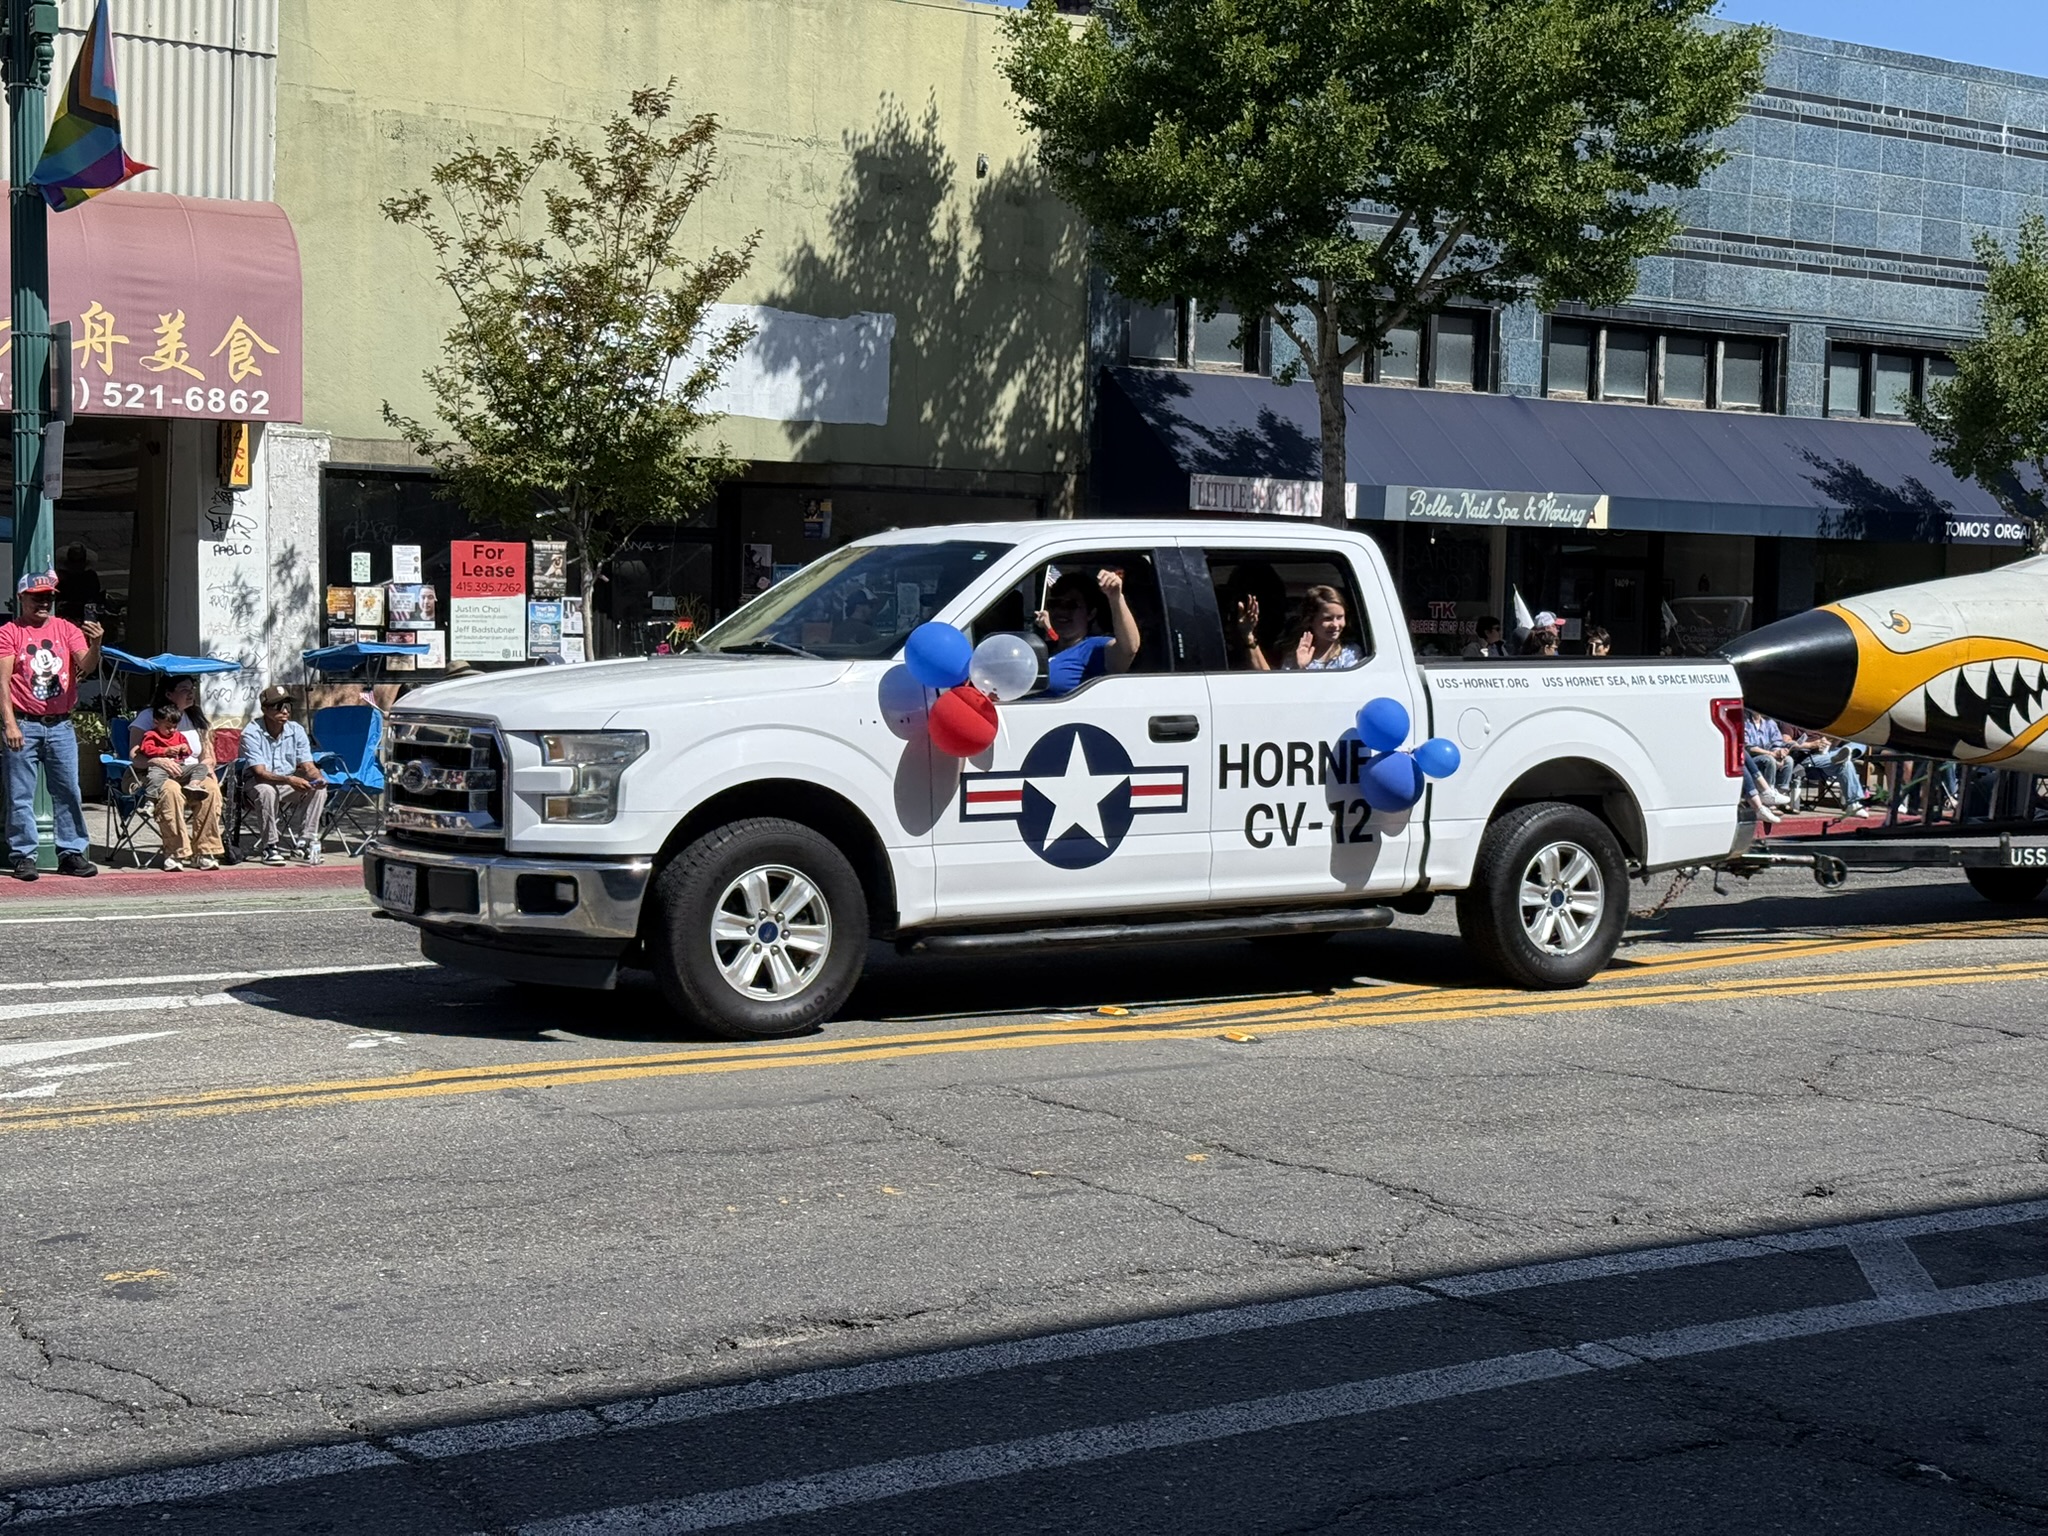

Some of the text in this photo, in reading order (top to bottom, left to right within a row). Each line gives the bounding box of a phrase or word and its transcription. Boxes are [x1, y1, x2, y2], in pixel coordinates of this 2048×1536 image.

[103, 382, 270, 415] 521-6862
[1409, 489, 1453, 517] Bella
[1454, 491, 1490, 520] Nail
[1493, 497, 1520, 524] Spa
[1524, 495, 1537, 521] &
[1945, 521, 1990, 538] TOMO'S
[473, 544, 505, 560] For
[462, 561, 516, 578] Lease
[455, 582, 522, 593] 415.395.7262
[455, 605, 501, 613] Justin Choi
[1428, 601, 1457, 619] TK
[1436, 673, 1731, 689] USS-HORNET.ORG USS HORNET SEA, AIR & SPACE MUSEUM
[1219, 739, 1372, 790] HORNE
[1244, 798, 1374, 849] CV-12
